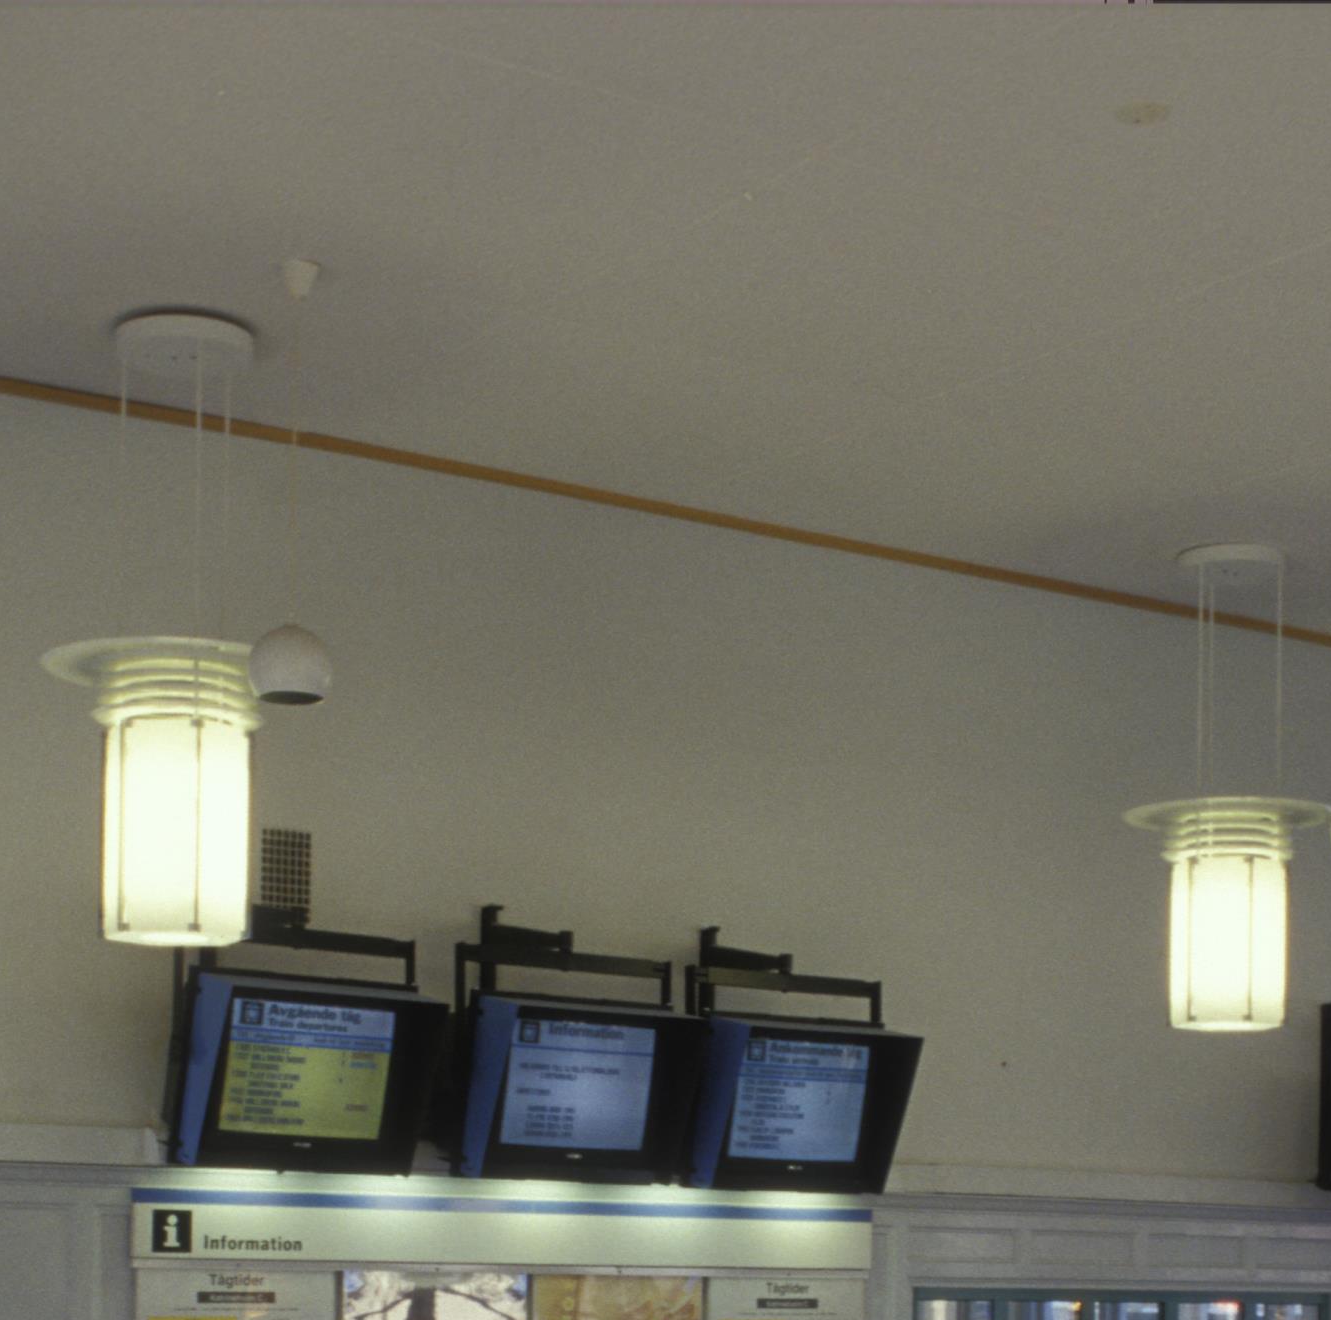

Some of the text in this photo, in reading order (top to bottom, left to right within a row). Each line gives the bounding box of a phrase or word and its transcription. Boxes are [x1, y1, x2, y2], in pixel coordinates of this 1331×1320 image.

[203, 1234, 303, 1251] Information
[208, 1272, 265, 1289] Tågtider
[766, 1281, 810, 1296] Tågtider
